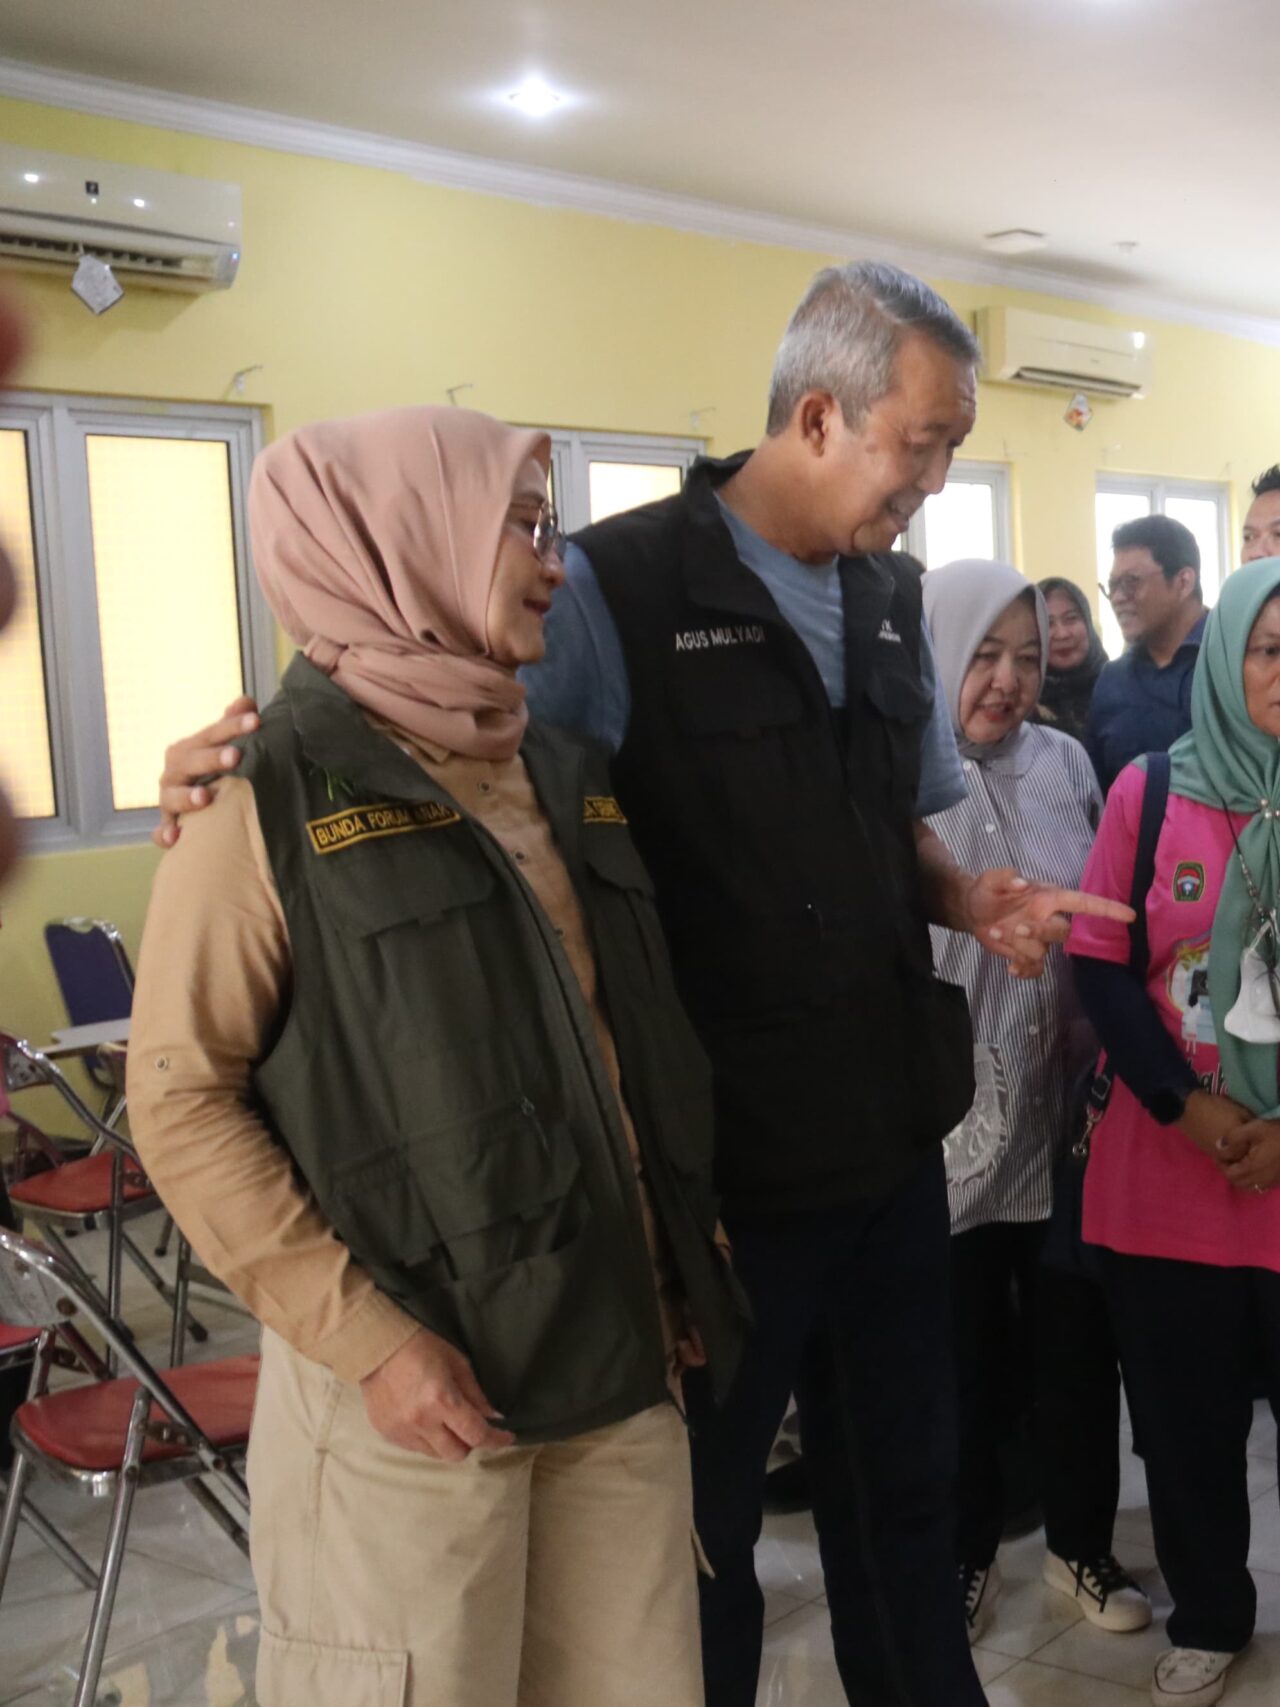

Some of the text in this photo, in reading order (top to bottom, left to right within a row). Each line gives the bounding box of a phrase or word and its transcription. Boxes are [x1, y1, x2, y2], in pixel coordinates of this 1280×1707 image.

[675, 625, 765, 651] AGUS MULYADI
[315, 816, 366, 846] BUNDA
[369, 806, 411, 829] FORUM
